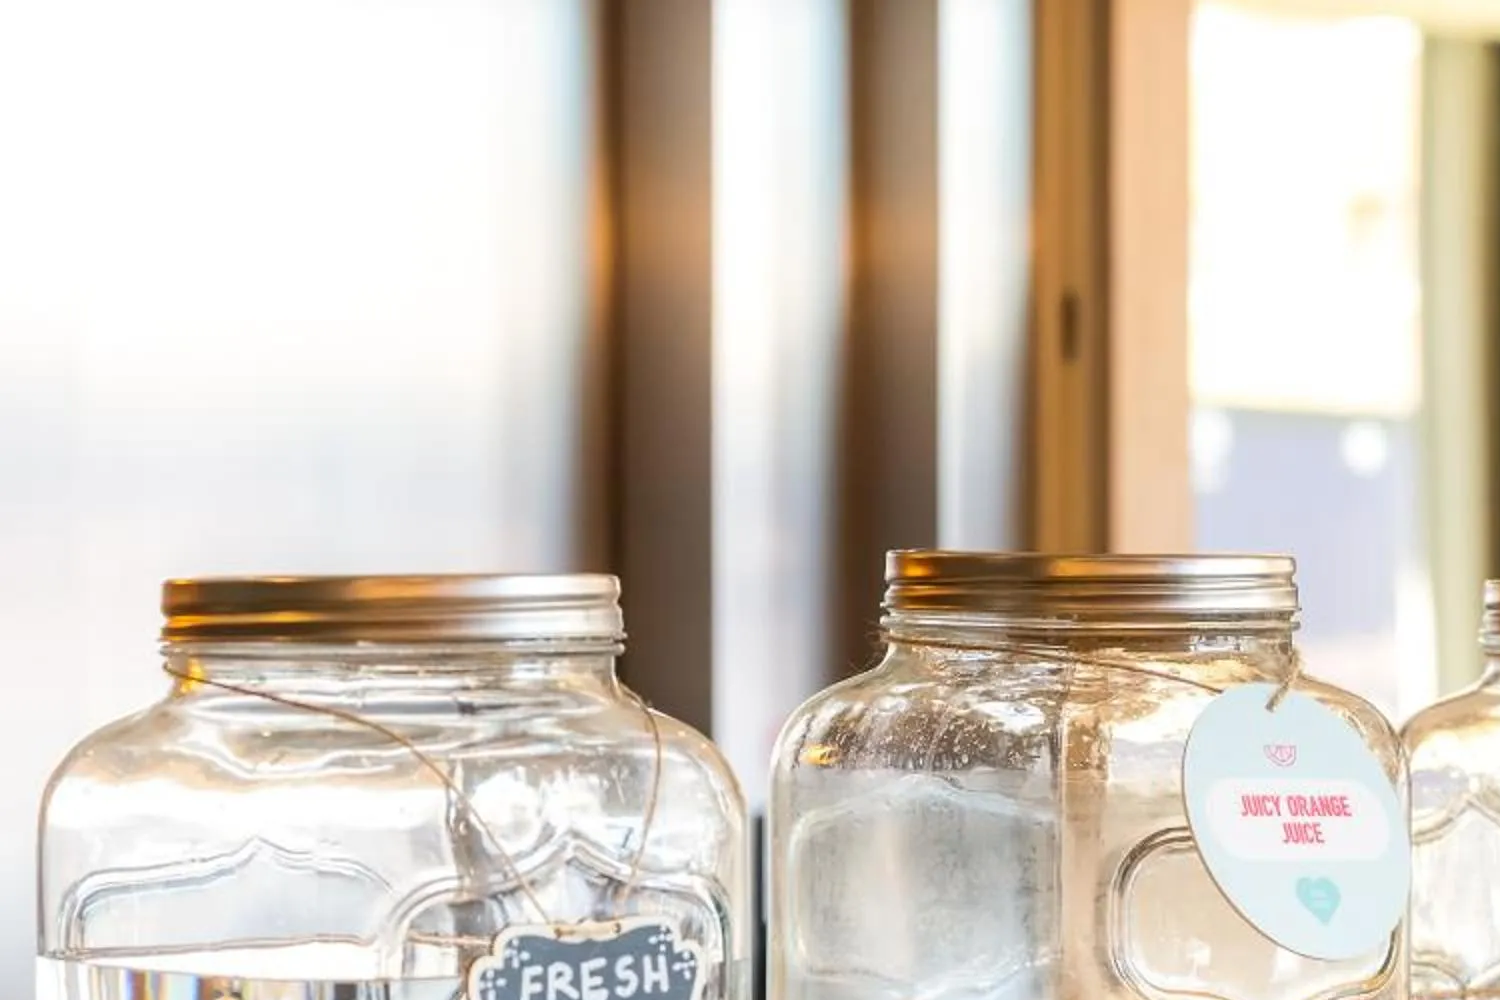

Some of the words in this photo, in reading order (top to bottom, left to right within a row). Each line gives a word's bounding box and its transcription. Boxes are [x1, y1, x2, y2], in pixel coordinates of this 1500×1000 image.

[1241, 794, 1281, 818] JUICY
[1287, 794, 1353, 818] ORANGE
[1282, 821, 1325, 845] JUICE
